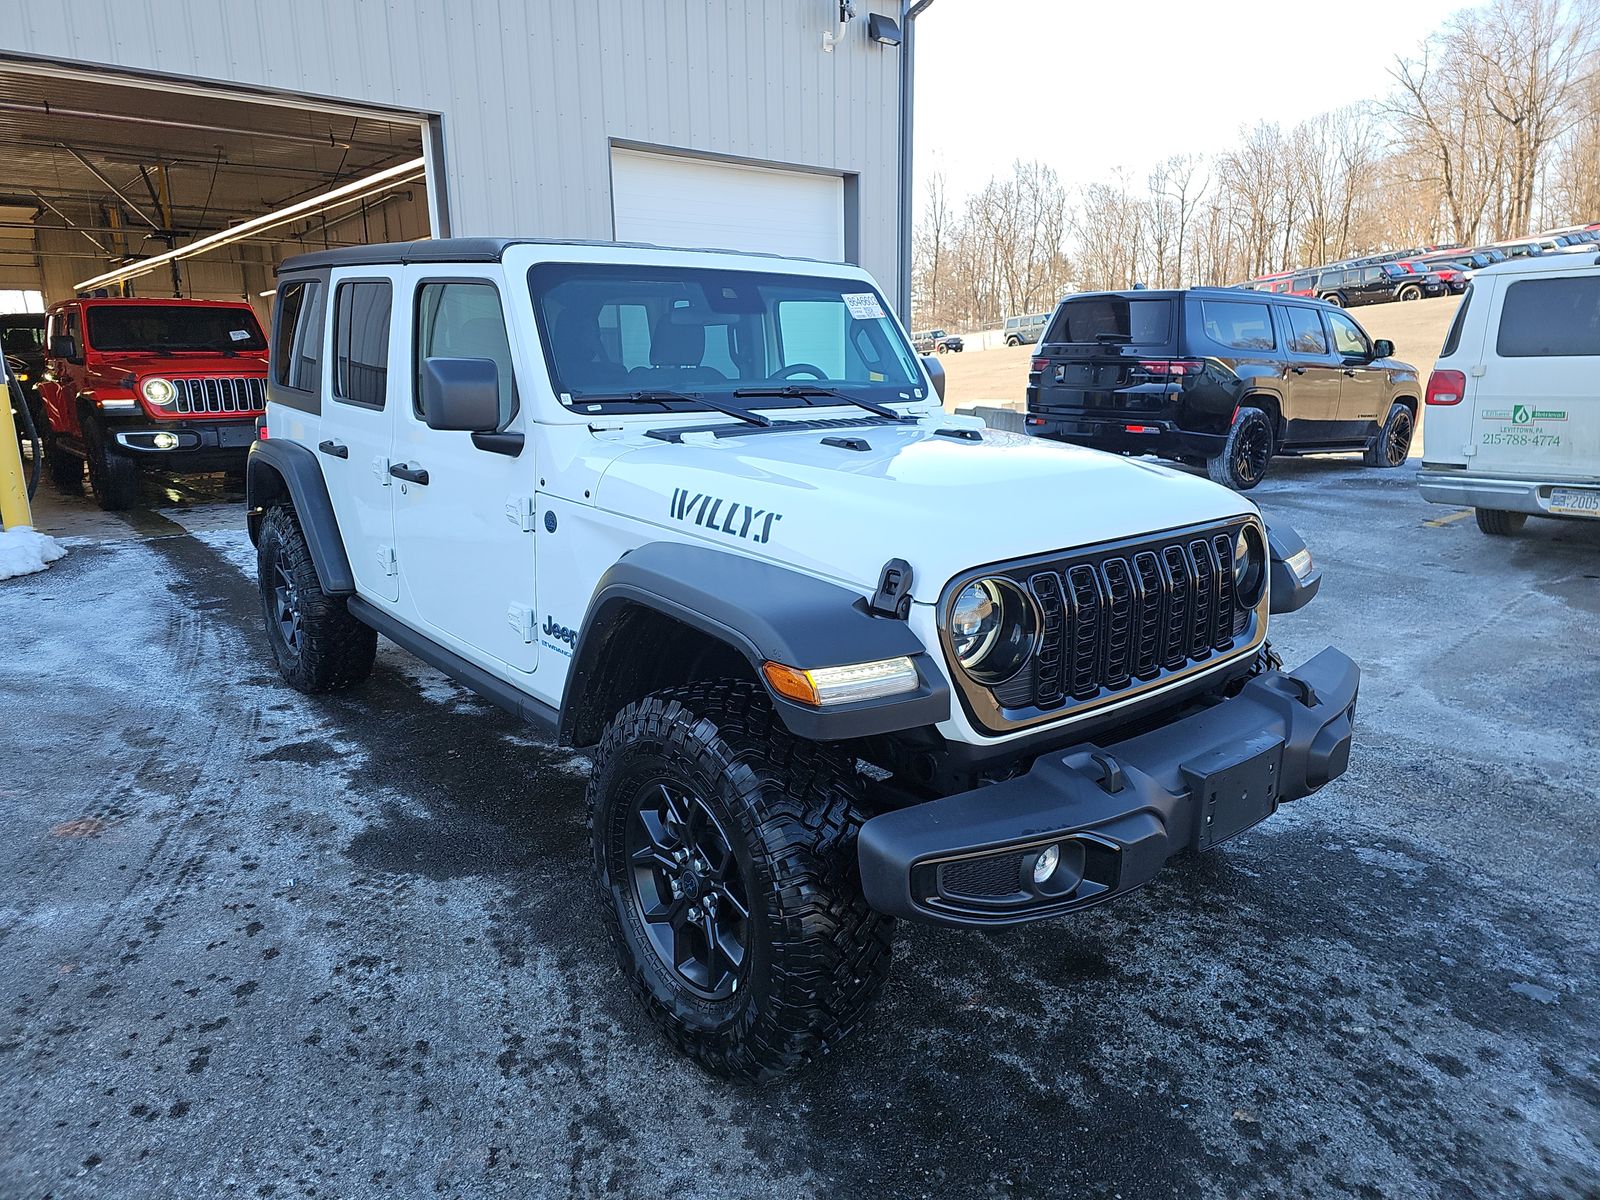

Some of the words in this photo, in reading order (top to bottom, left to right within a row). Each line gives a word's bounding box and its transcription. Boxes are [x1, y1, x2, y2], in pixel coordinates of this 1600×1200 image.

[1483, 433, 1560, 446] 215-788-4774
[670, 487, 783, 544] WILLYS
[543, 615, 578, 649] Jeep
